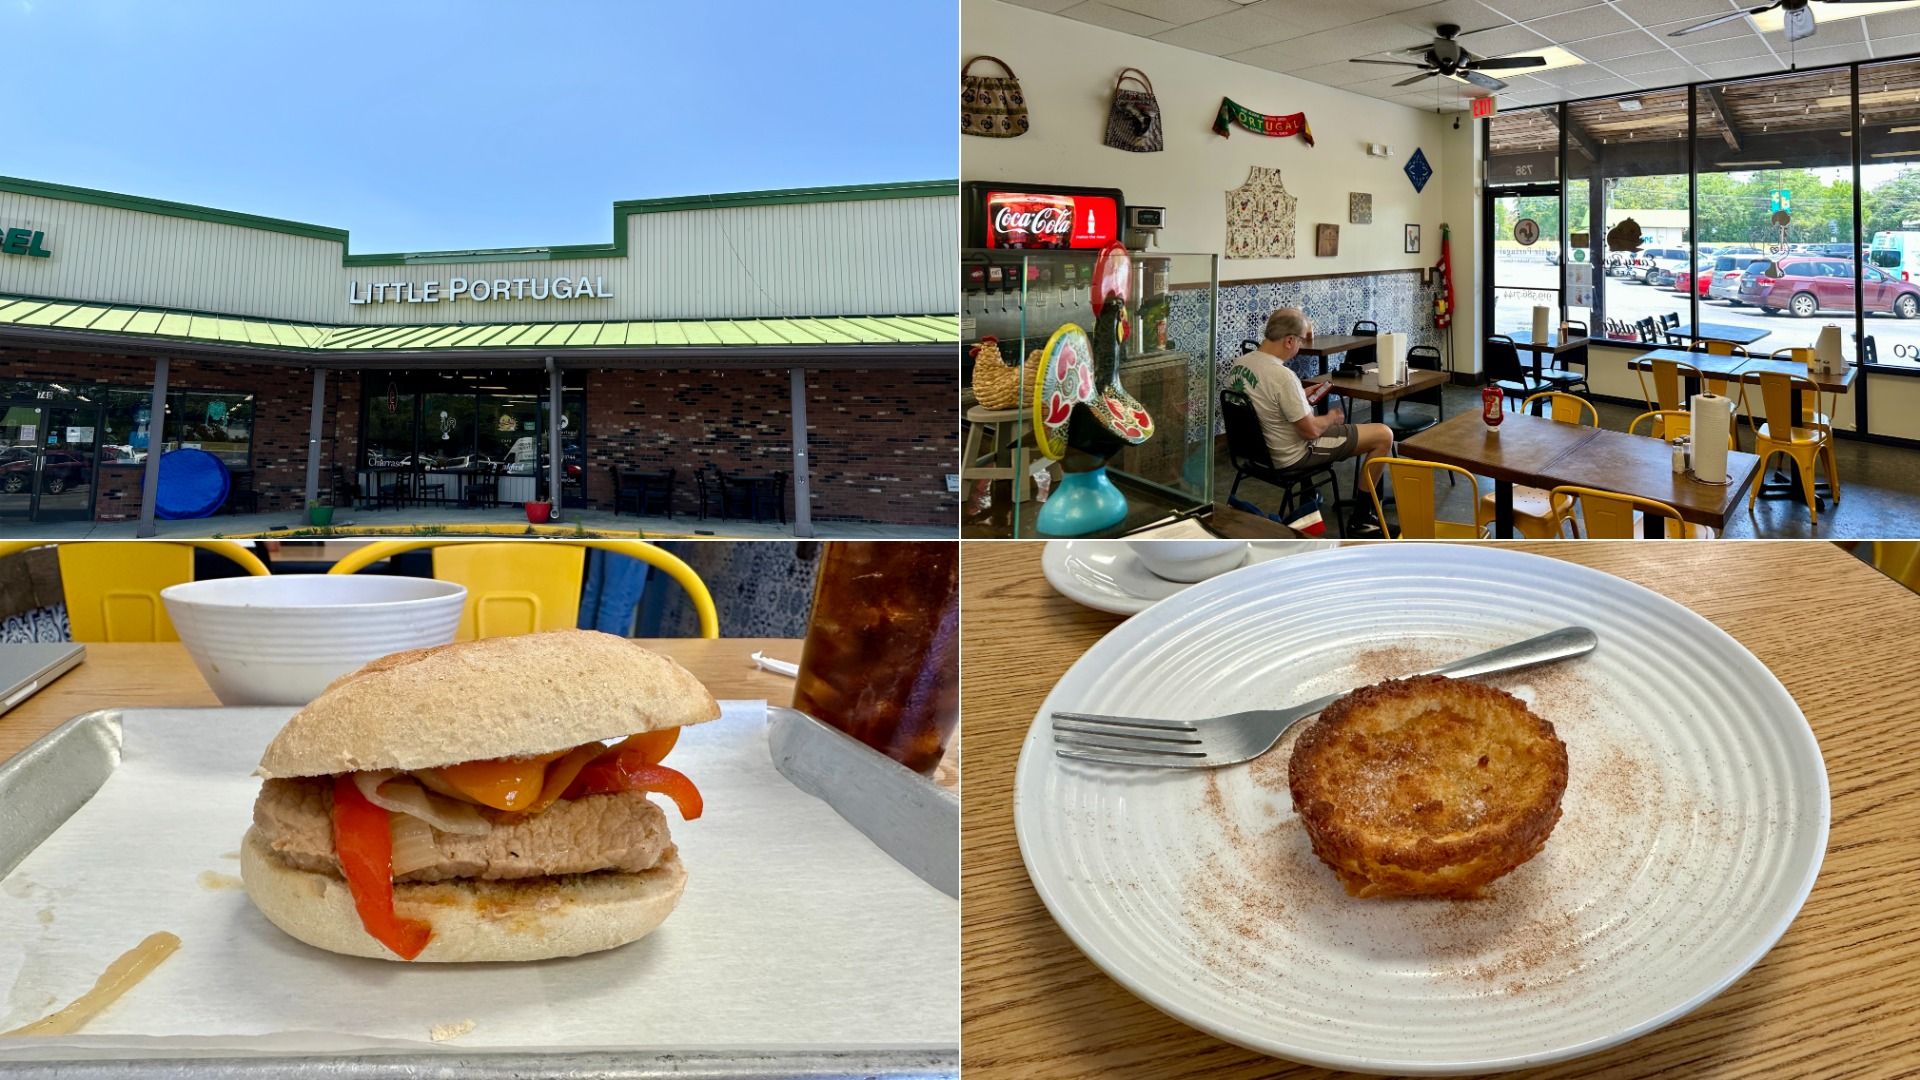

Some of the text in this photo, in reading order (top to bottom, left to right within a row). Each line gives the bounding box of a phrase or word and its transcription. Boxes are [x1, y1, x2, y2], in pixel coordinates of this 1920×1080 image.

[1238, 111, 1299, 131] ORTUGAL
[1473, 97, 1493, 118] EXIT
[995, 206, 1072, 234] Coca-Cola
[0, 227, 52, 258] EL
[350, 277, 614, 304] LITTLE PORTUGAL
